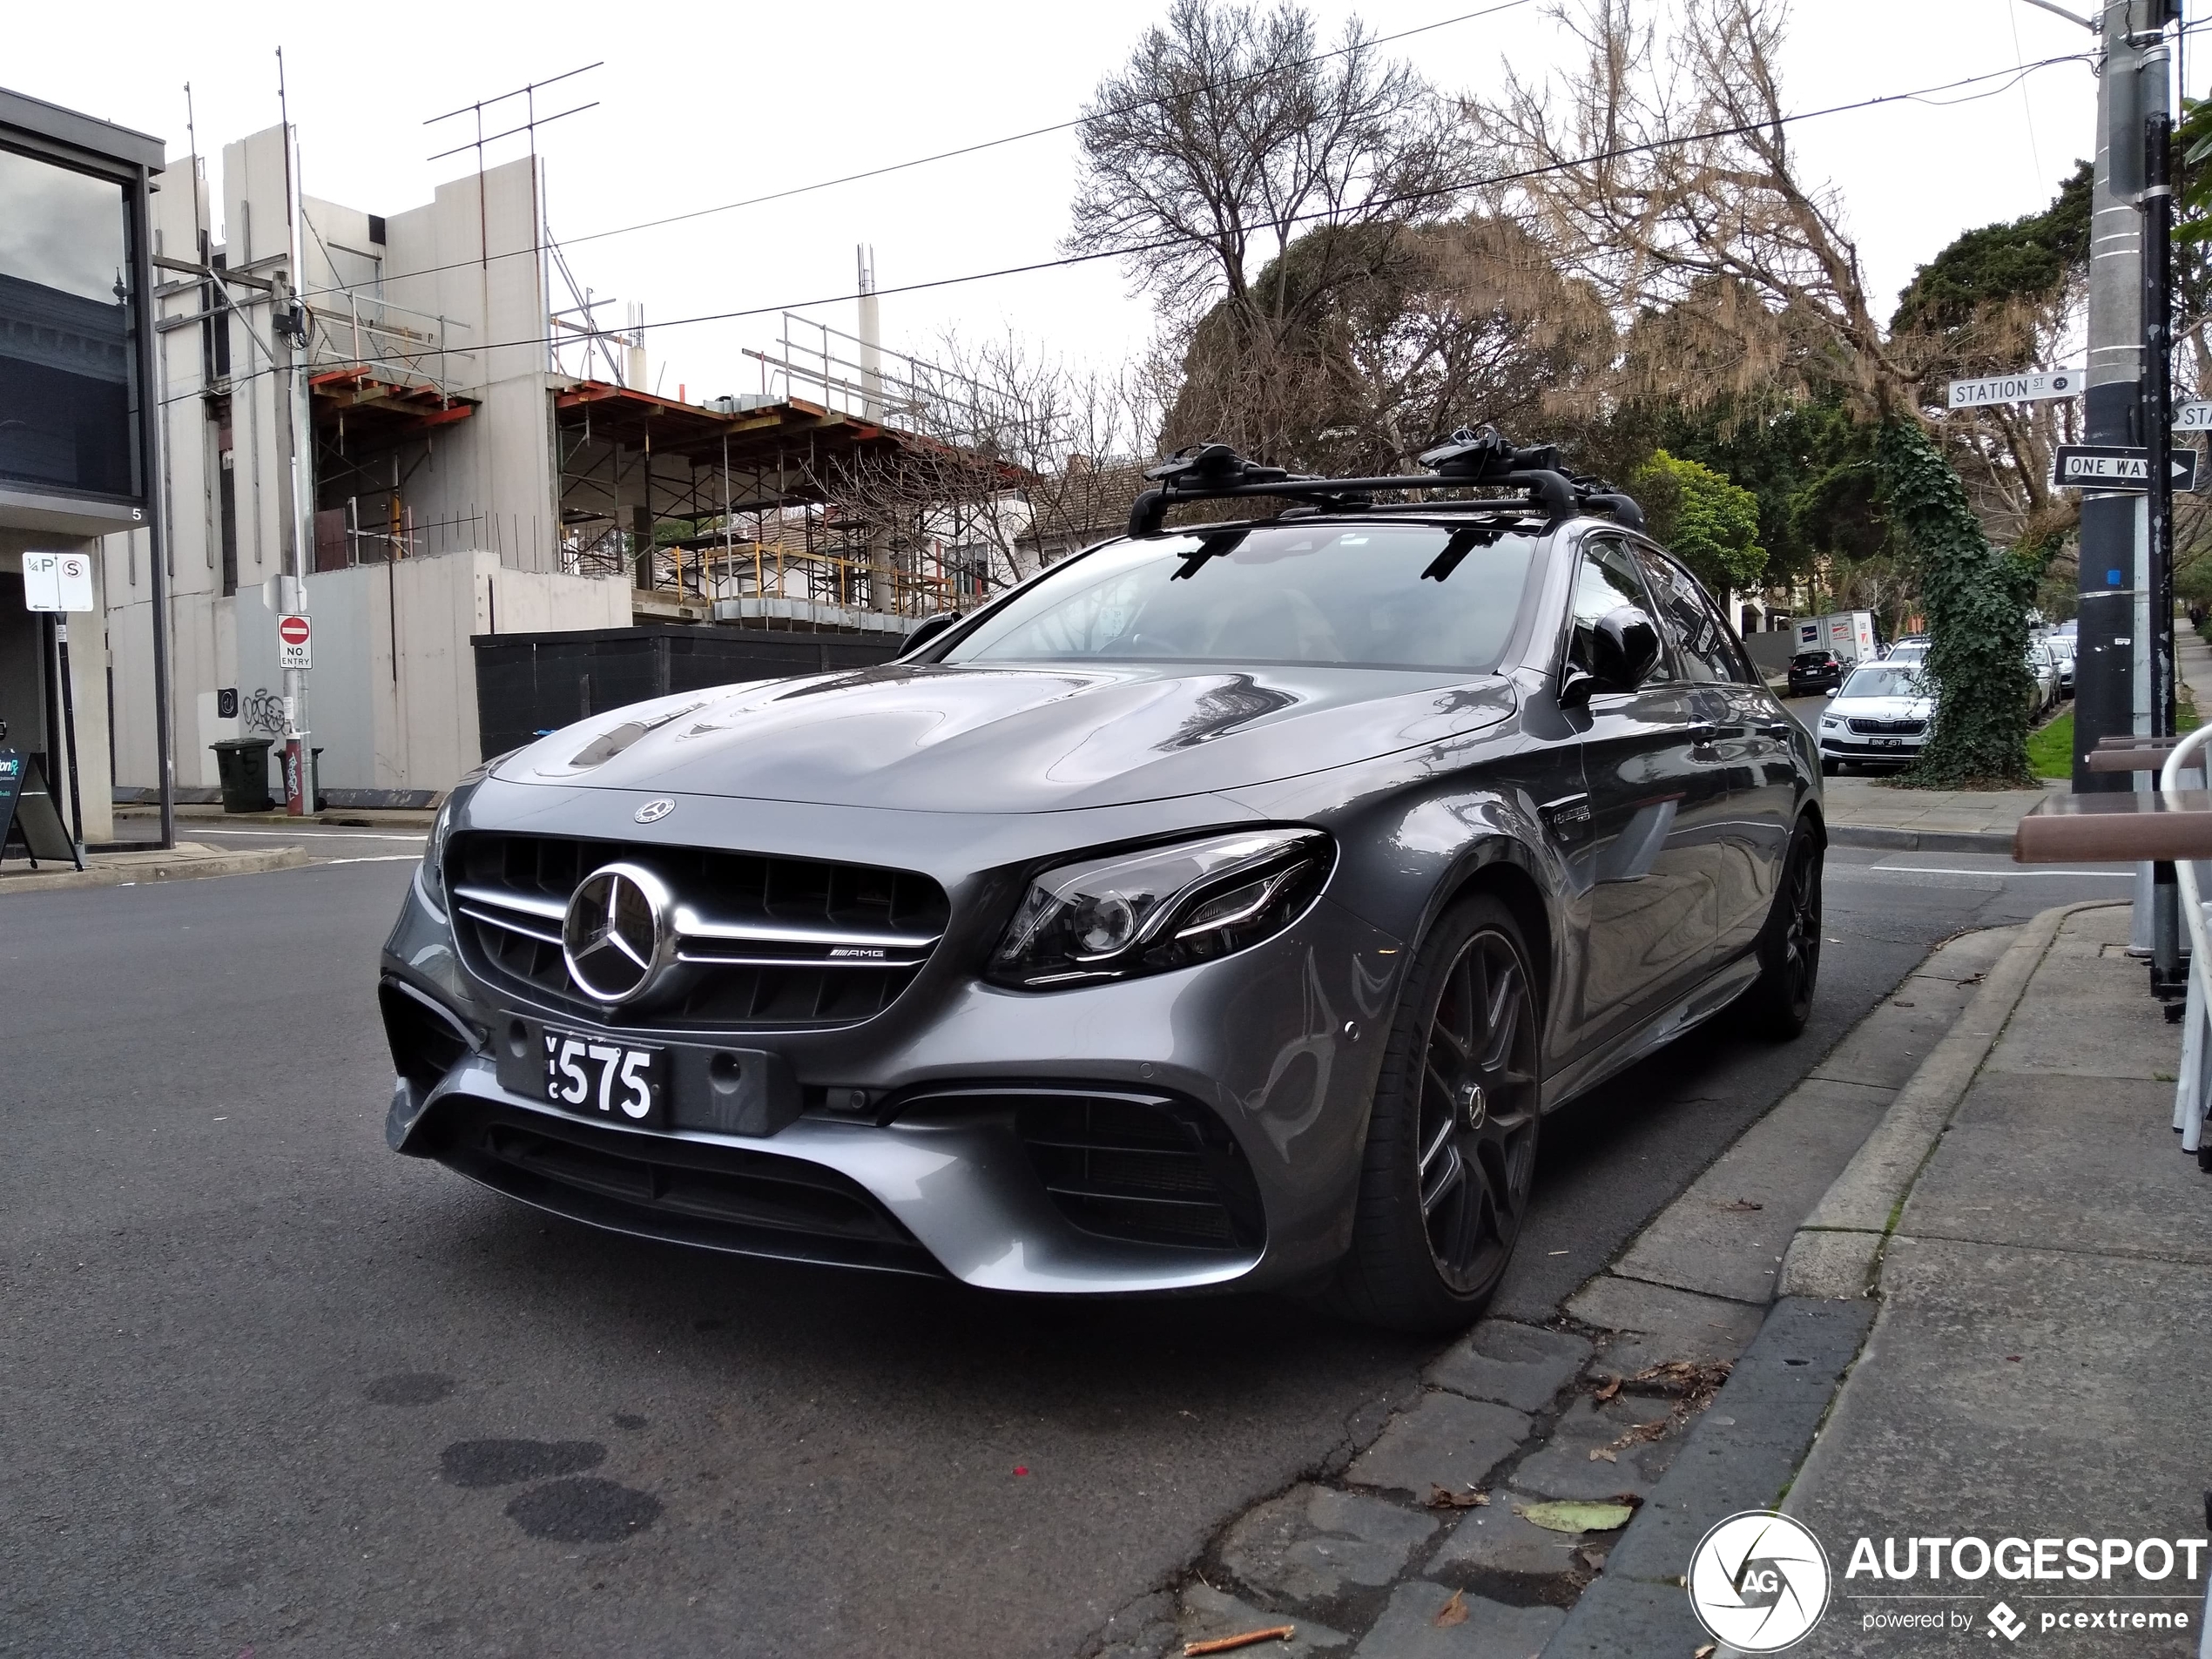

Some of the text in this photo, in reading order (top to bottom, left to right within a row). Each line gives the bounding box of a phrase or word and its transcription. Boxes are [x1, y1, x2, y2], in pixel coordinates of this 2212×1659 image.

[1956, 380, 2027, 402] STATION
[2033, 378, 2044, 387] ST
[2071, 458, 2106, 474] ONE
[132, 509, 141, 520] 5
[545, 1035, 559, 1099] VIC
[559, 1040, 651, 1119] 575
